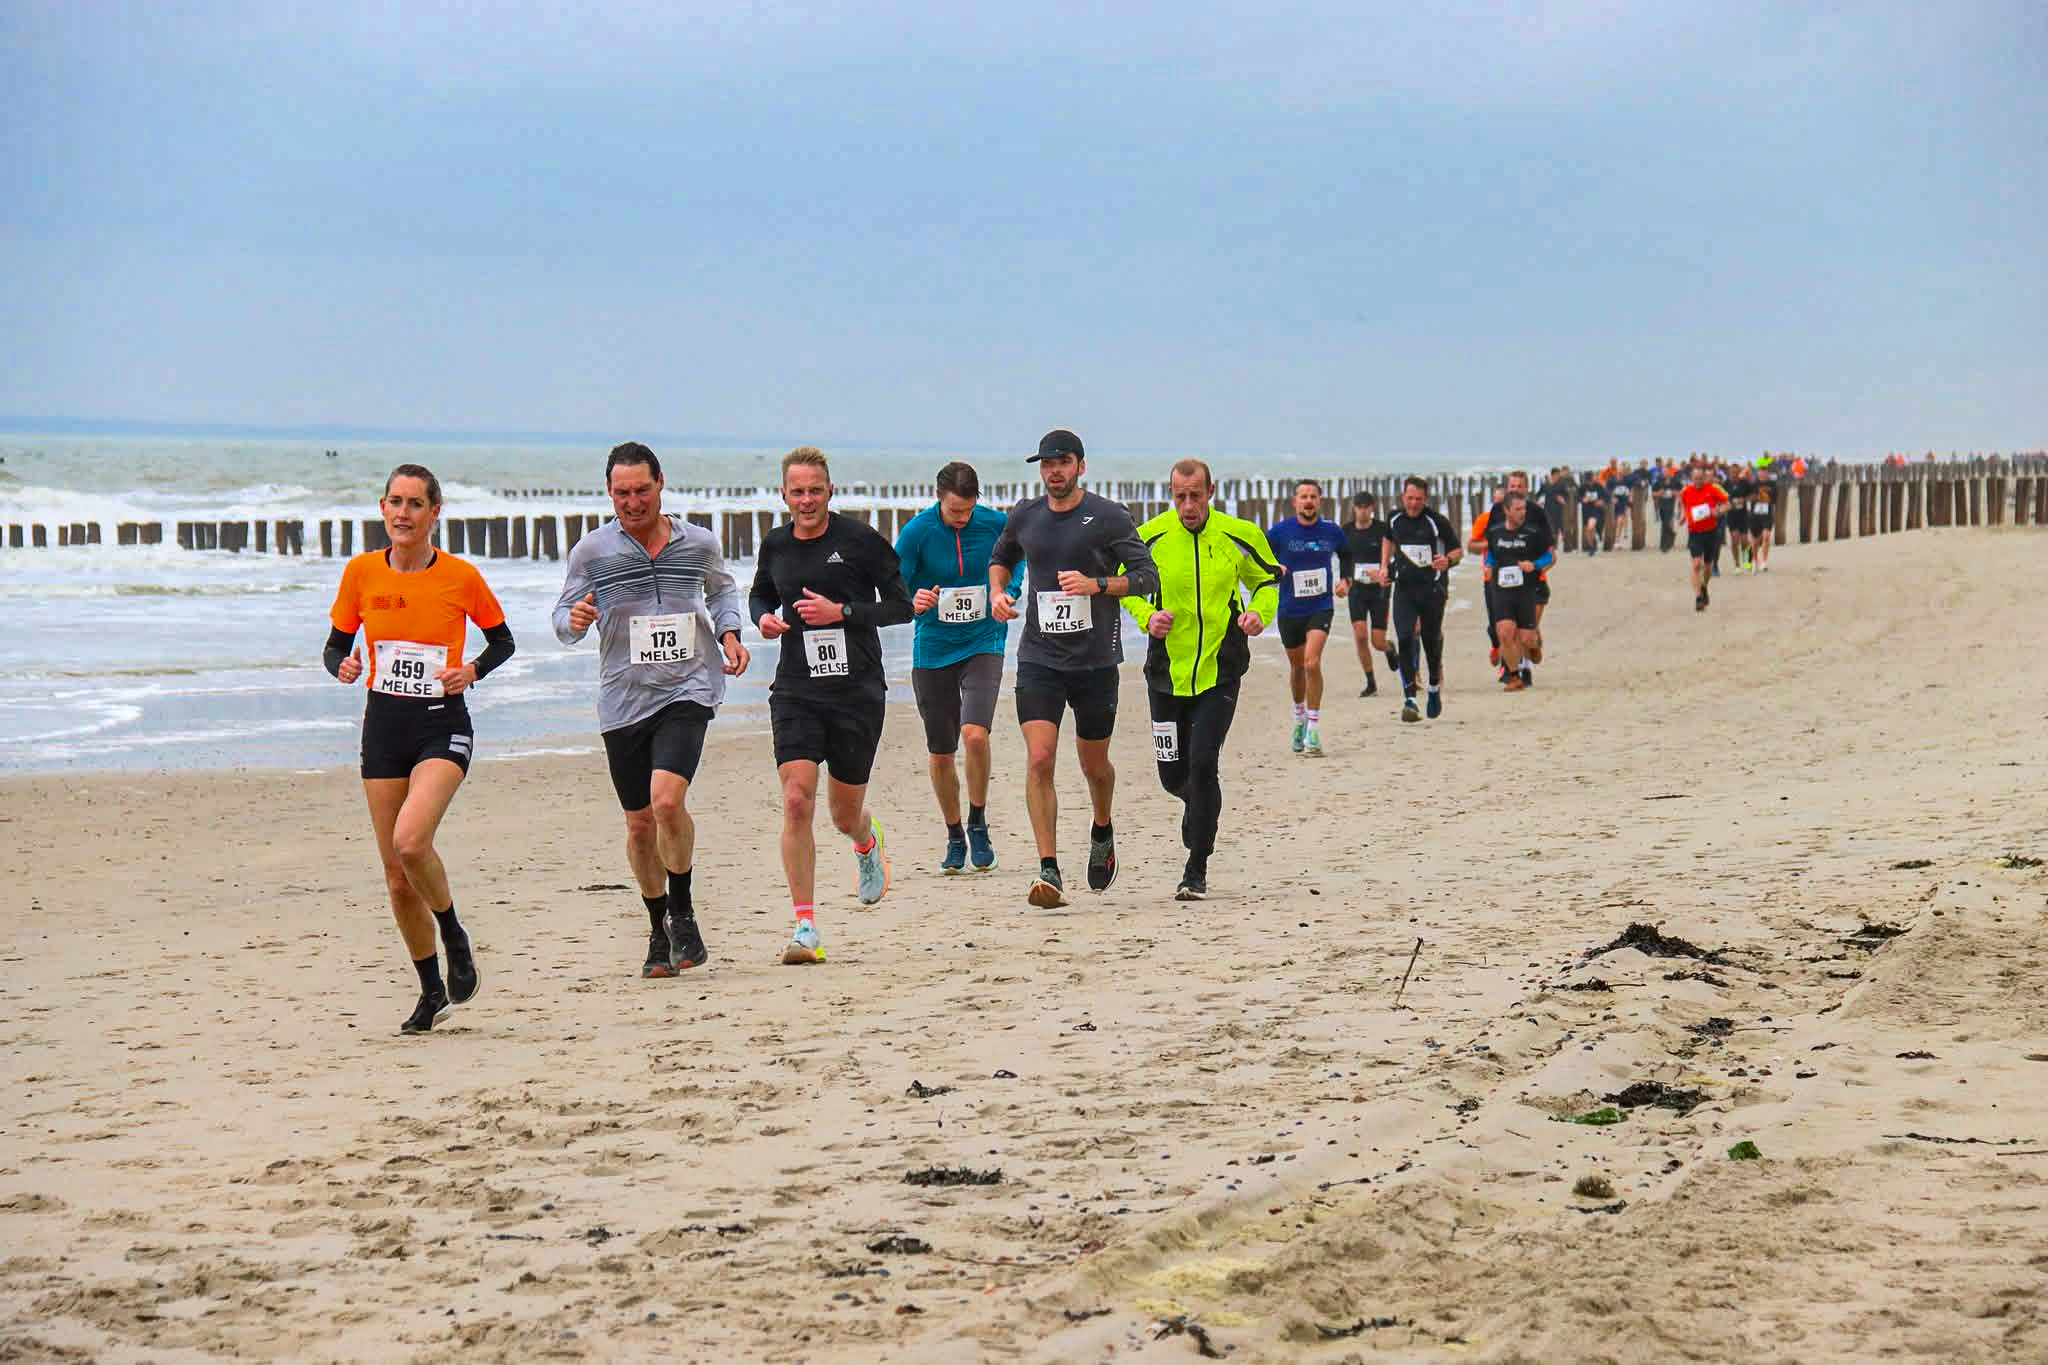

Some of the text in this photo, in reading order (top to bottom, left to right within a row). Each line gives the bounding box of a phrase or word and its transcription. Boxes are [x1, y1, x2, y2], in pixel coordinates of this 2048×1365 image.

[956, 598, 972, 610] 39
[945, 611, 981, 621] MELSE
[1056, 604, 1071, 619] 27
[1045, 620, 1084, 631] MELSE
[651, 630, 676, 648] 173
[640, 648, 687, 661] MELSE
[817, 645, 837, 661] 80
[392, 659, 424, 680] 459
[808, 663, 848, 675] MELSE
[382, 679, 433, 696] MELSE
[1155, 750, 1180, 760] ELSE
